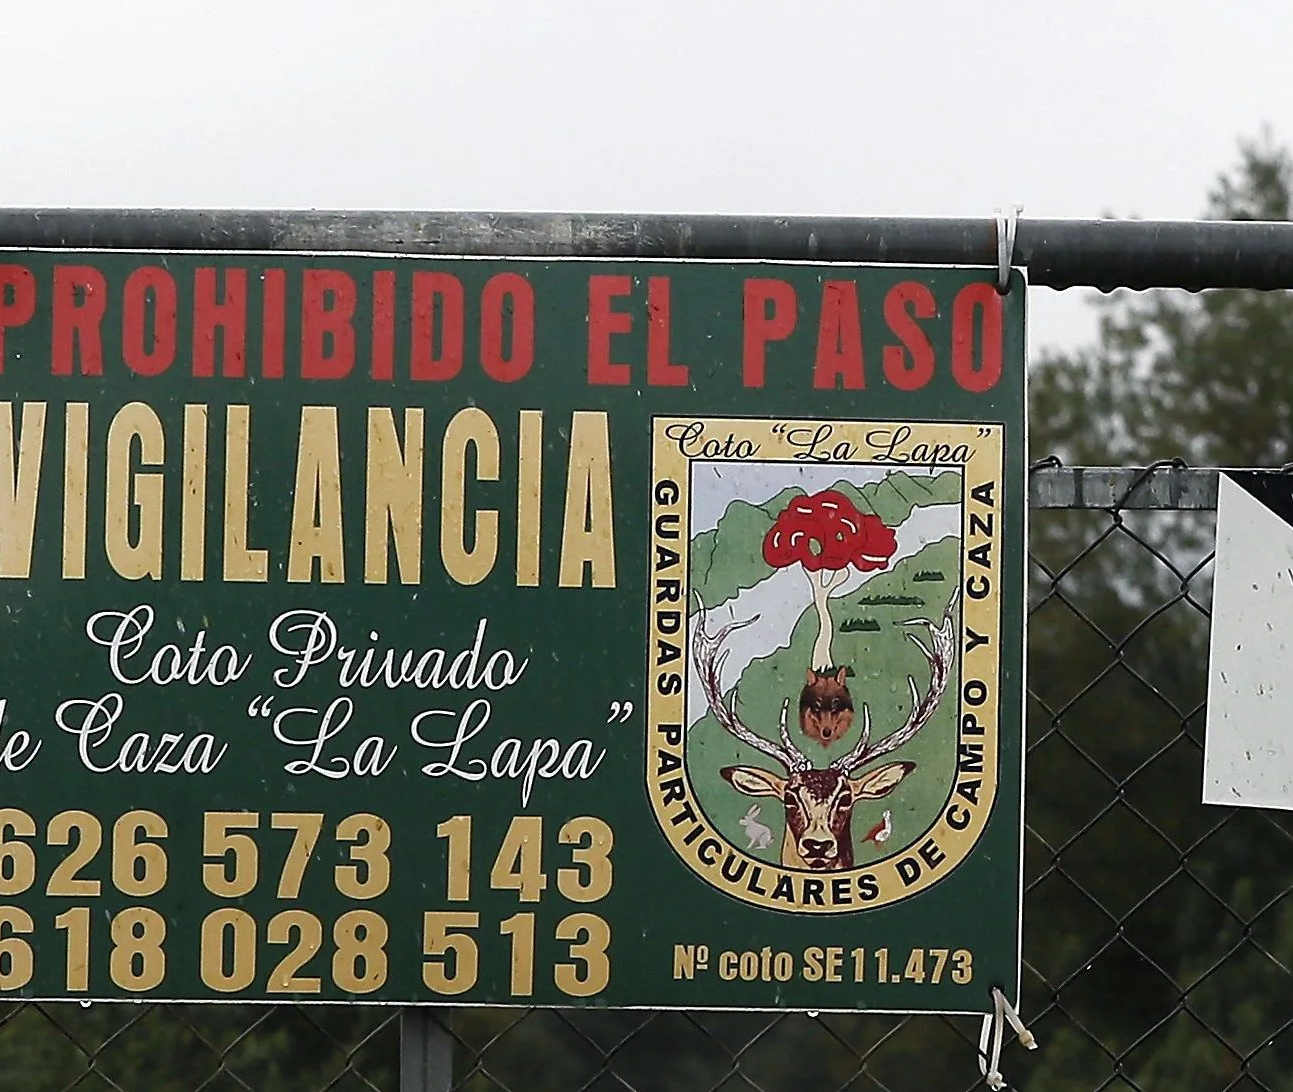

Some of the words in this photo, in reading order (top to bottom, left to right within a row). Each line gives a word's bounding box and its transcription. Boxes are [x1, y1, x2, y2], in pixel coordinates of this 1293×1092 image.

[587, 274, 690, 387] EL
[742, 278, 1003, 393] PASO
[665, 421, 761, 460] Coto
[771, 422, 858, 461] “La
[866, 425, 992, 474] Lapa”
[966, 481, 995, 599] CAZA
[654, 480, 682, 696] GUARDAS
[86, 605, 252, 687] Coto
[269, 609, 528, 690] Privado
[965, 626, 990, 654] Y
[55, 693, 228, 774] Caza
[247, 695, 398, 779] “La
[411, 698, 633, 808] Lapa”
[946, 680, 989, 832] CAMPO
[201, 811, 393, 899] 573
[436, 814, 614, 903] 143
[657, 723, 880, 905] PARTICULARES
[896, 840, 946, 887] DE
[200, 907, 389, 995] 028
[422, 911, 611, 998] 513
[718, 946, 794, 981] coto
